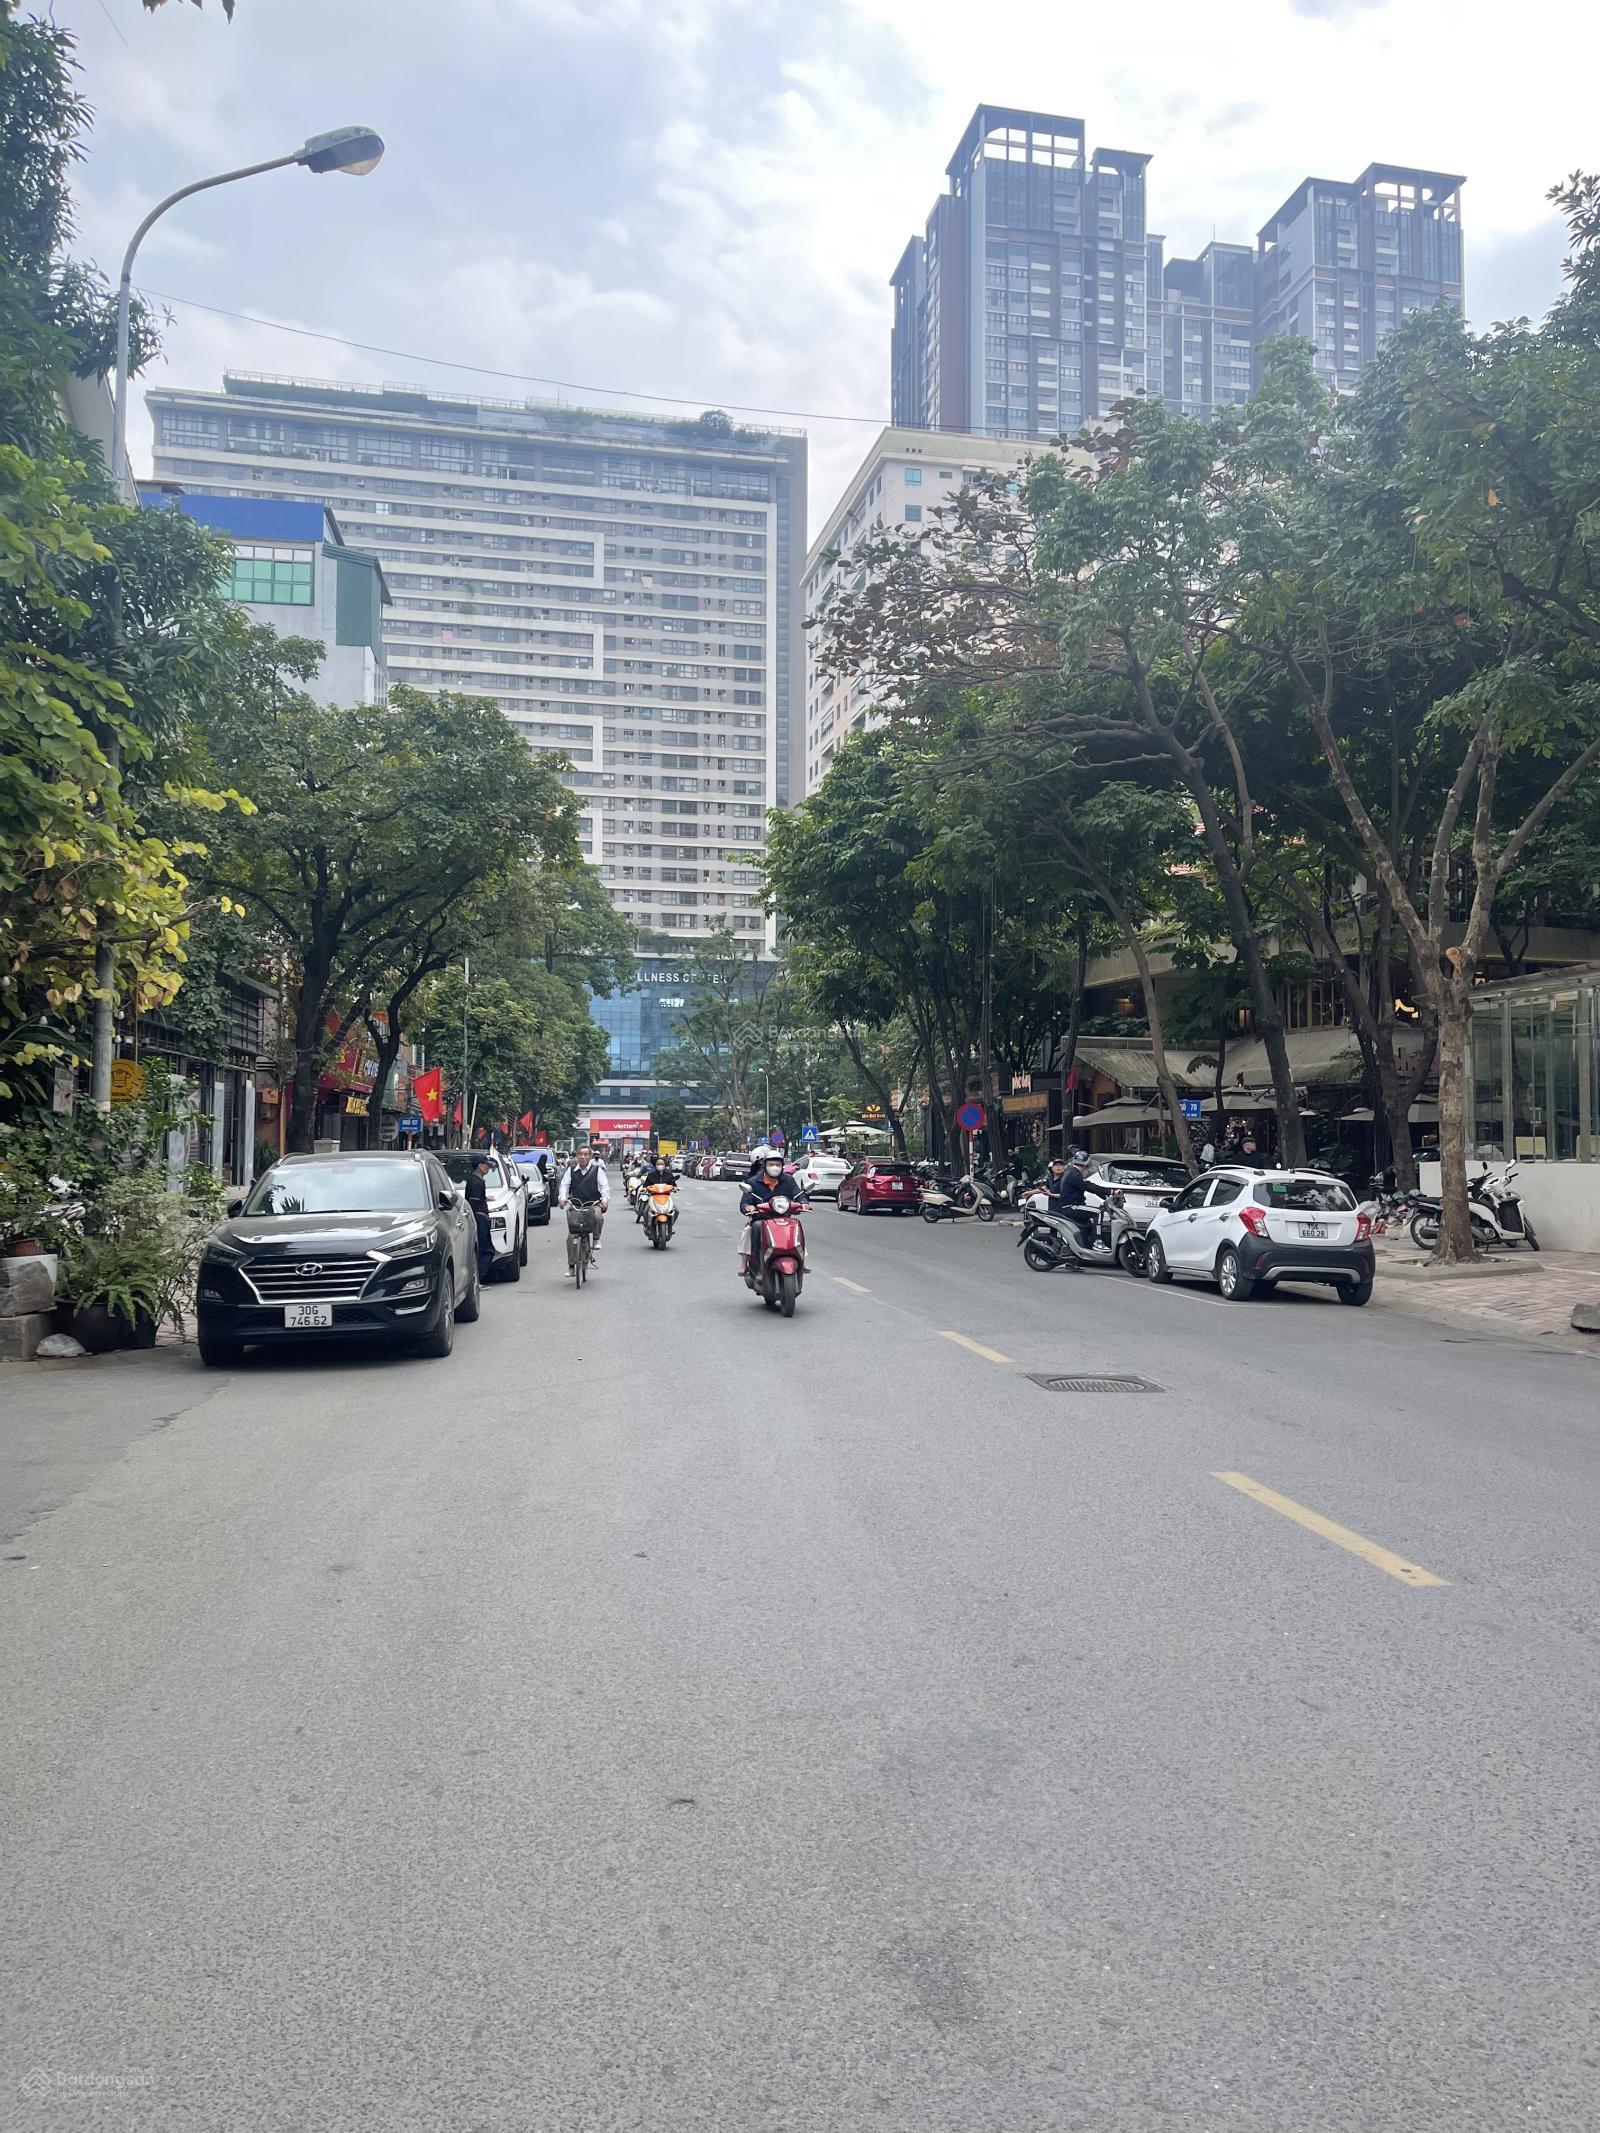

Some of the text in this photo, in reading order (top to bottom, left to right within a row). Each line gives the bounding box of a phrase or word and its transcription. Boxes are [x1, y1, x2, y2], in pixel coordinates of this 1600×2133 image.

[637, 973, 680, 983] LLNESS
[298, 1305, 319, 1315] 30G
[290, 1315, 327, 1325] 746.62
